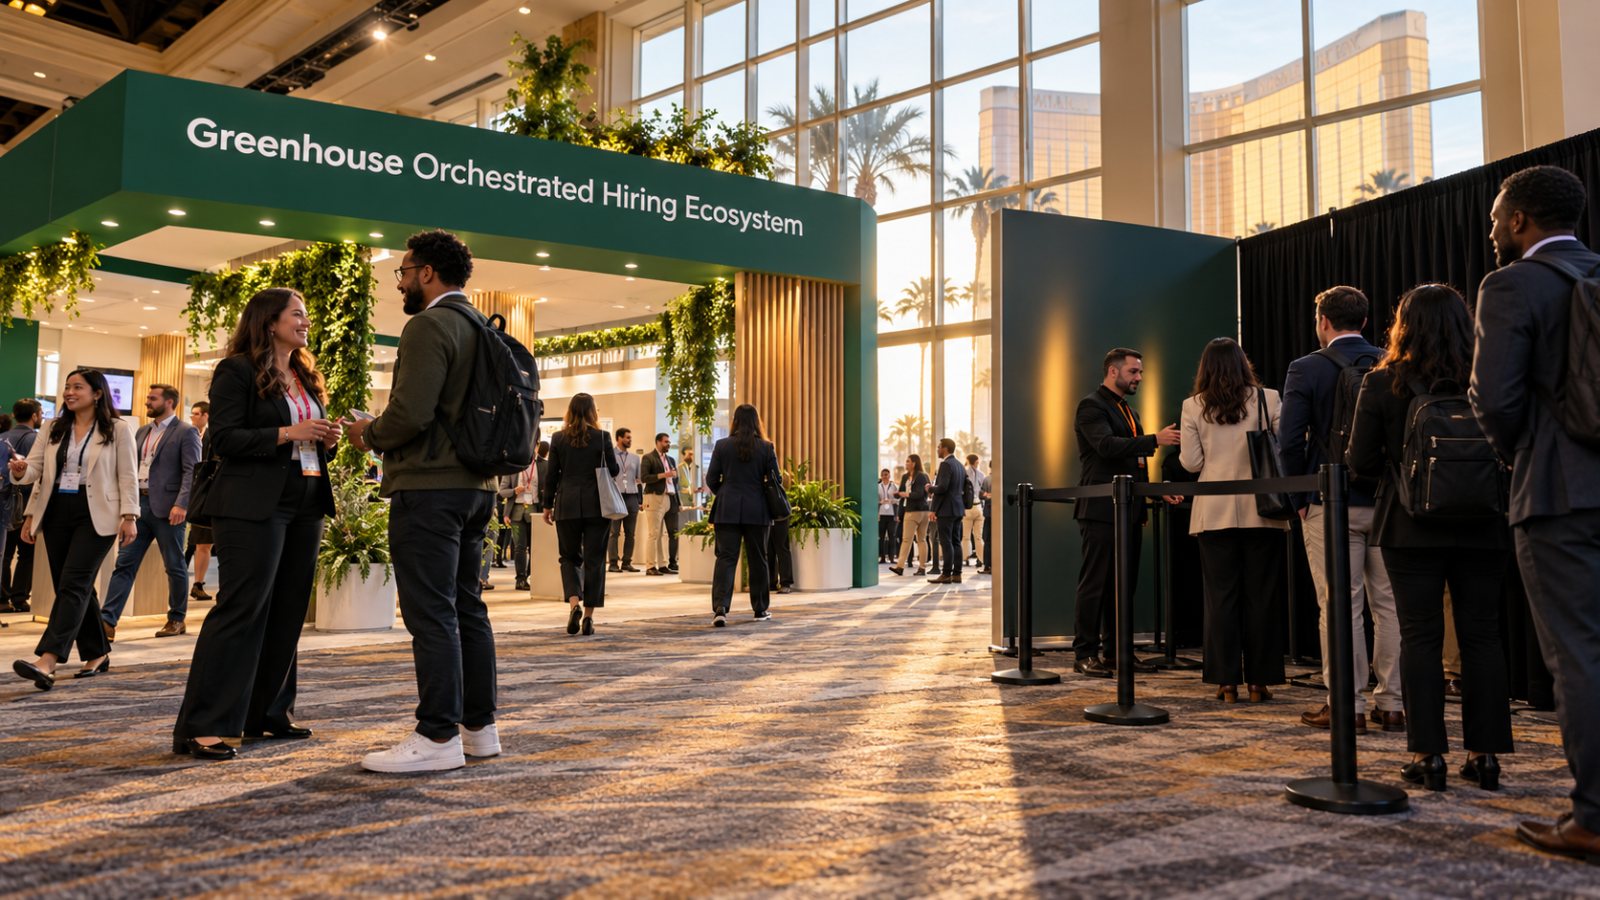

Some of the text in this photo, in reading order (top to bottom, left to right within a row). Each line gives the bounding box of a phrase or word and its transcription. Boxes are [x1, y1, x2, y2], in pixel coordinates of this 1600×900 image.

[186, 117, 803, 237] Greenhouse Orchestrated Hiring Ecosystem
